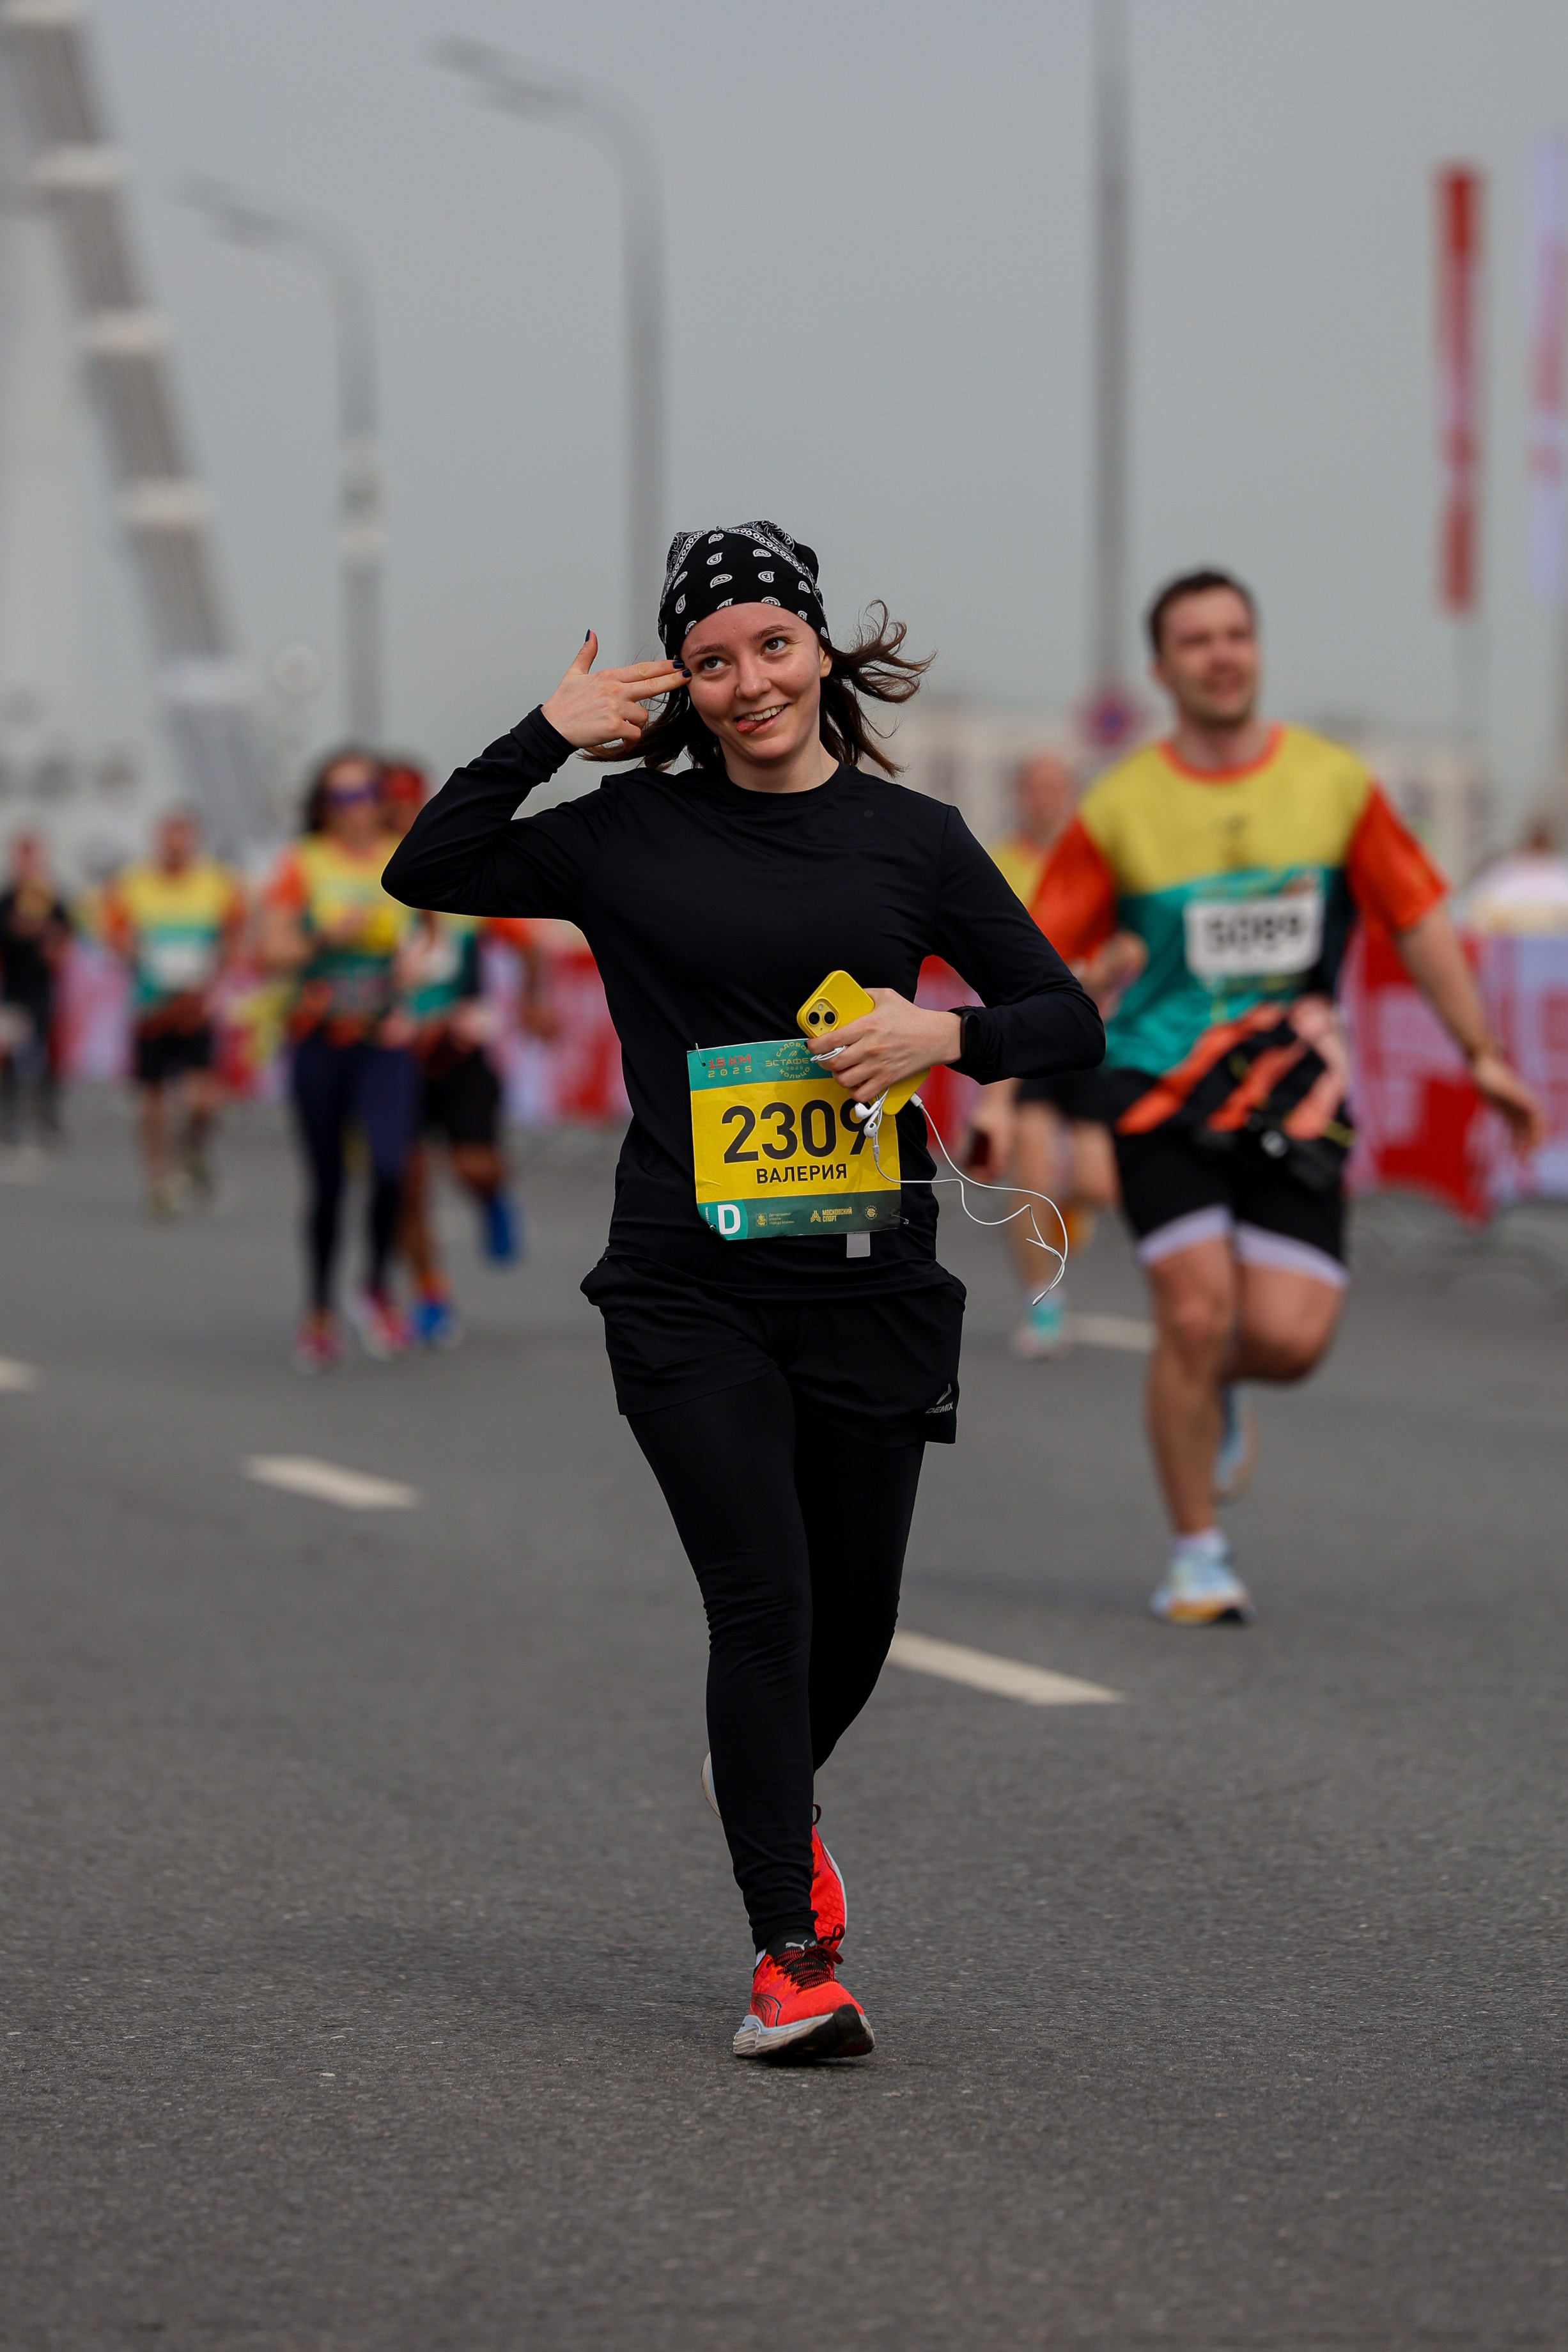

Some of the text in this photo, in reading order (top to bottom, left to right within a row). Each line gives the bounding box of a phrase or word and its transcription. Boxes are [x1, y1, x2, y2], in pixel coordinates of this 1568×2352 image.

[776, 1041, 811, 1057] САДОВОЕ
[708, 1057, 726, 1069] 15
[708, 1066, 752, 1078] 2025
[780, 1067, 810, 1079] КОЛЬЦО
[722, 1098, 871, 1164] 2309
[756, 1164, 847, 1184] ВАЛЕРИЯ
[822, 1207, 852, 1216] МОСКОВСКИЙ
[717, 1204, 741, 1234] D
[925, 1401, 954, 1414] DEMIX
